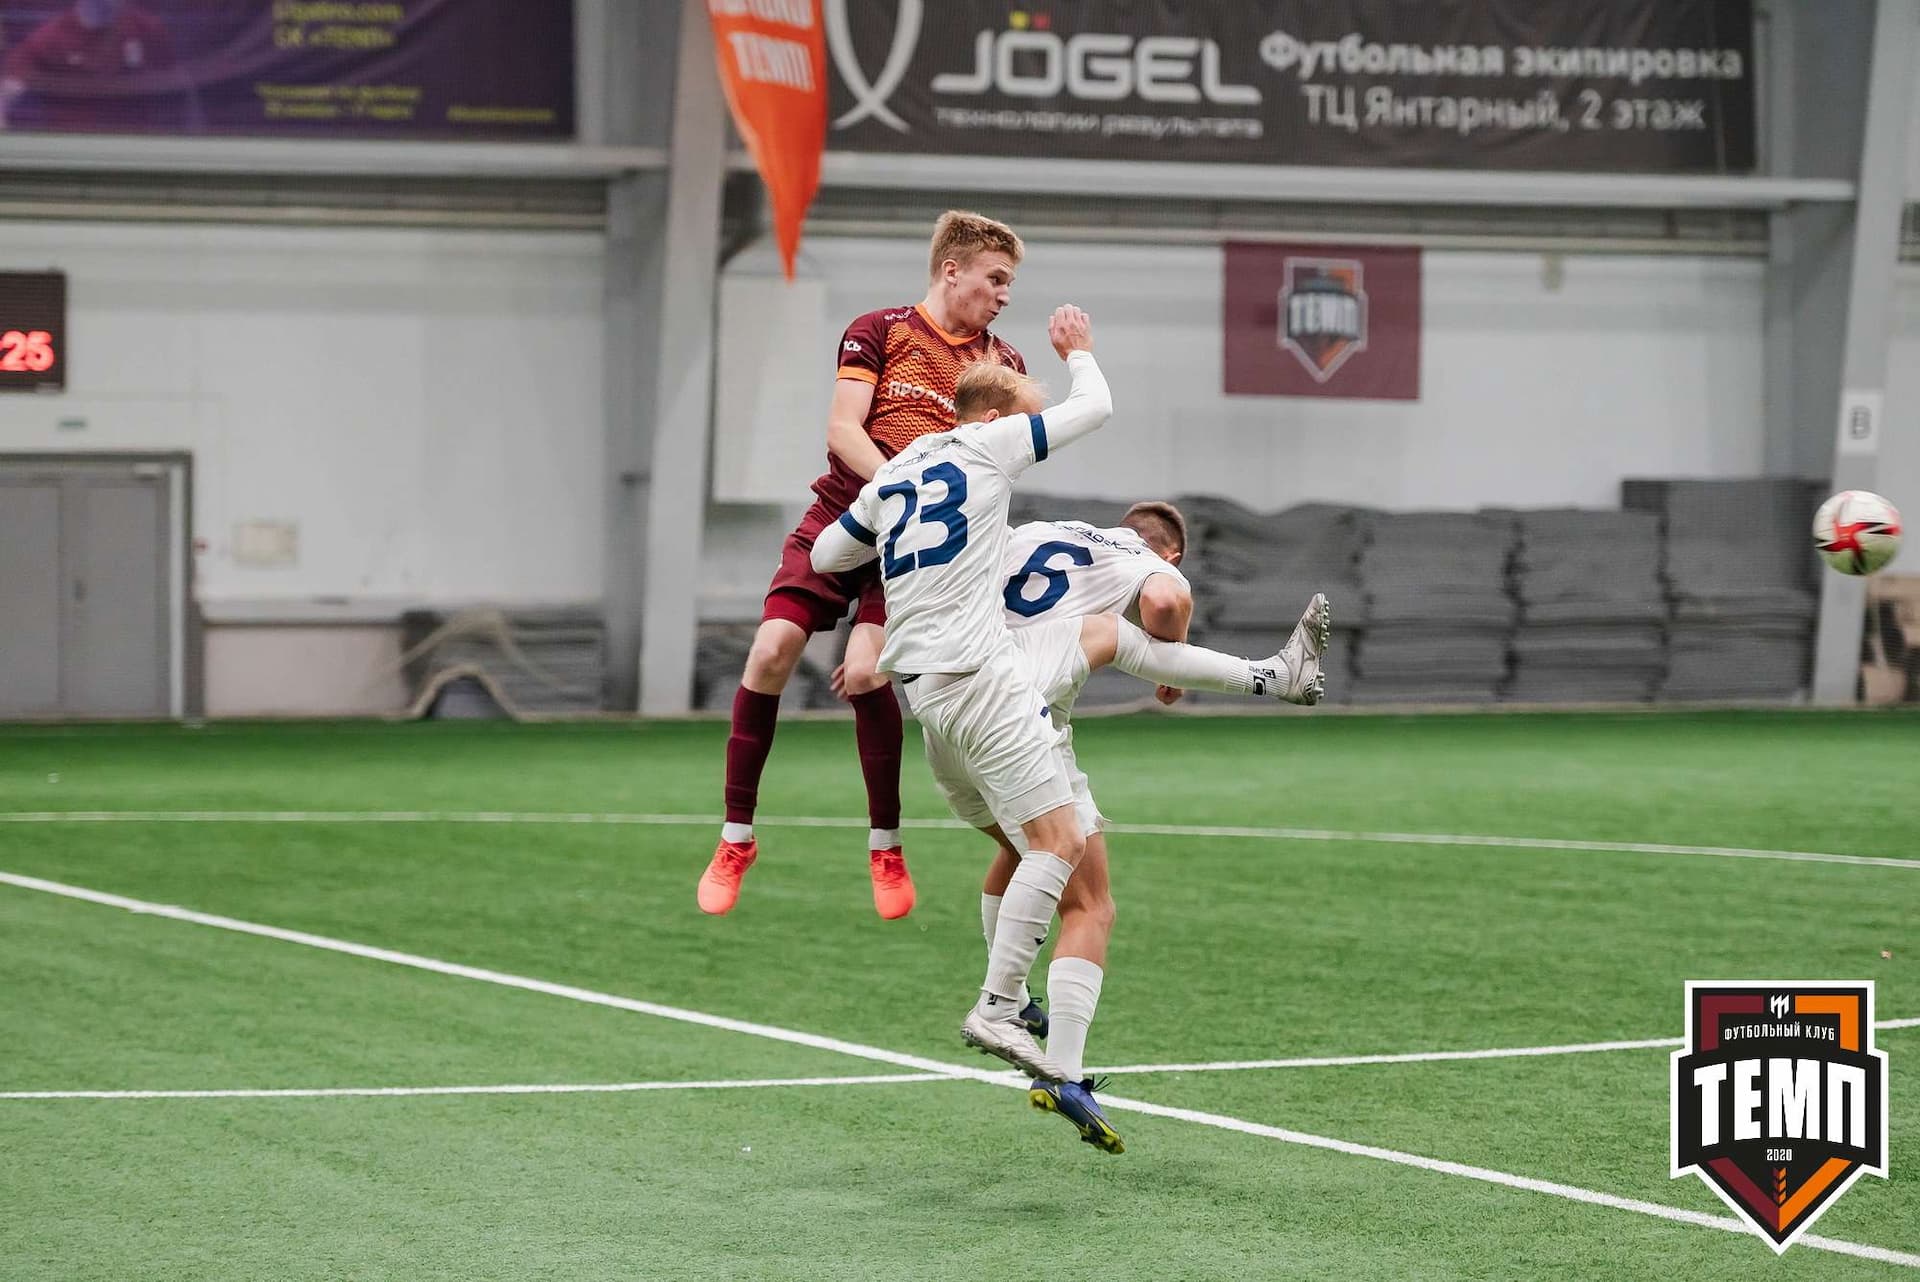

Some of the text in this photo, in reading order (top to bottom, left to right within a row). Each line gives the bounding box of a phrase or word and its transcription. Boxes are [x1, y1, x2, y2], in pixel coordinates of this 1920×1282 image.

[930, 10, 1262, 105] JÖGEL
[1258, 30, 1743, 87] Футбольная экипировка
[1301, 84, 1706, 137] ТЦ Янтарный, 2 этаж
[0, 329, 54, 372] 25
[878, 461, 968, 580] 23
[1003, 541, 1094, 617] 6
